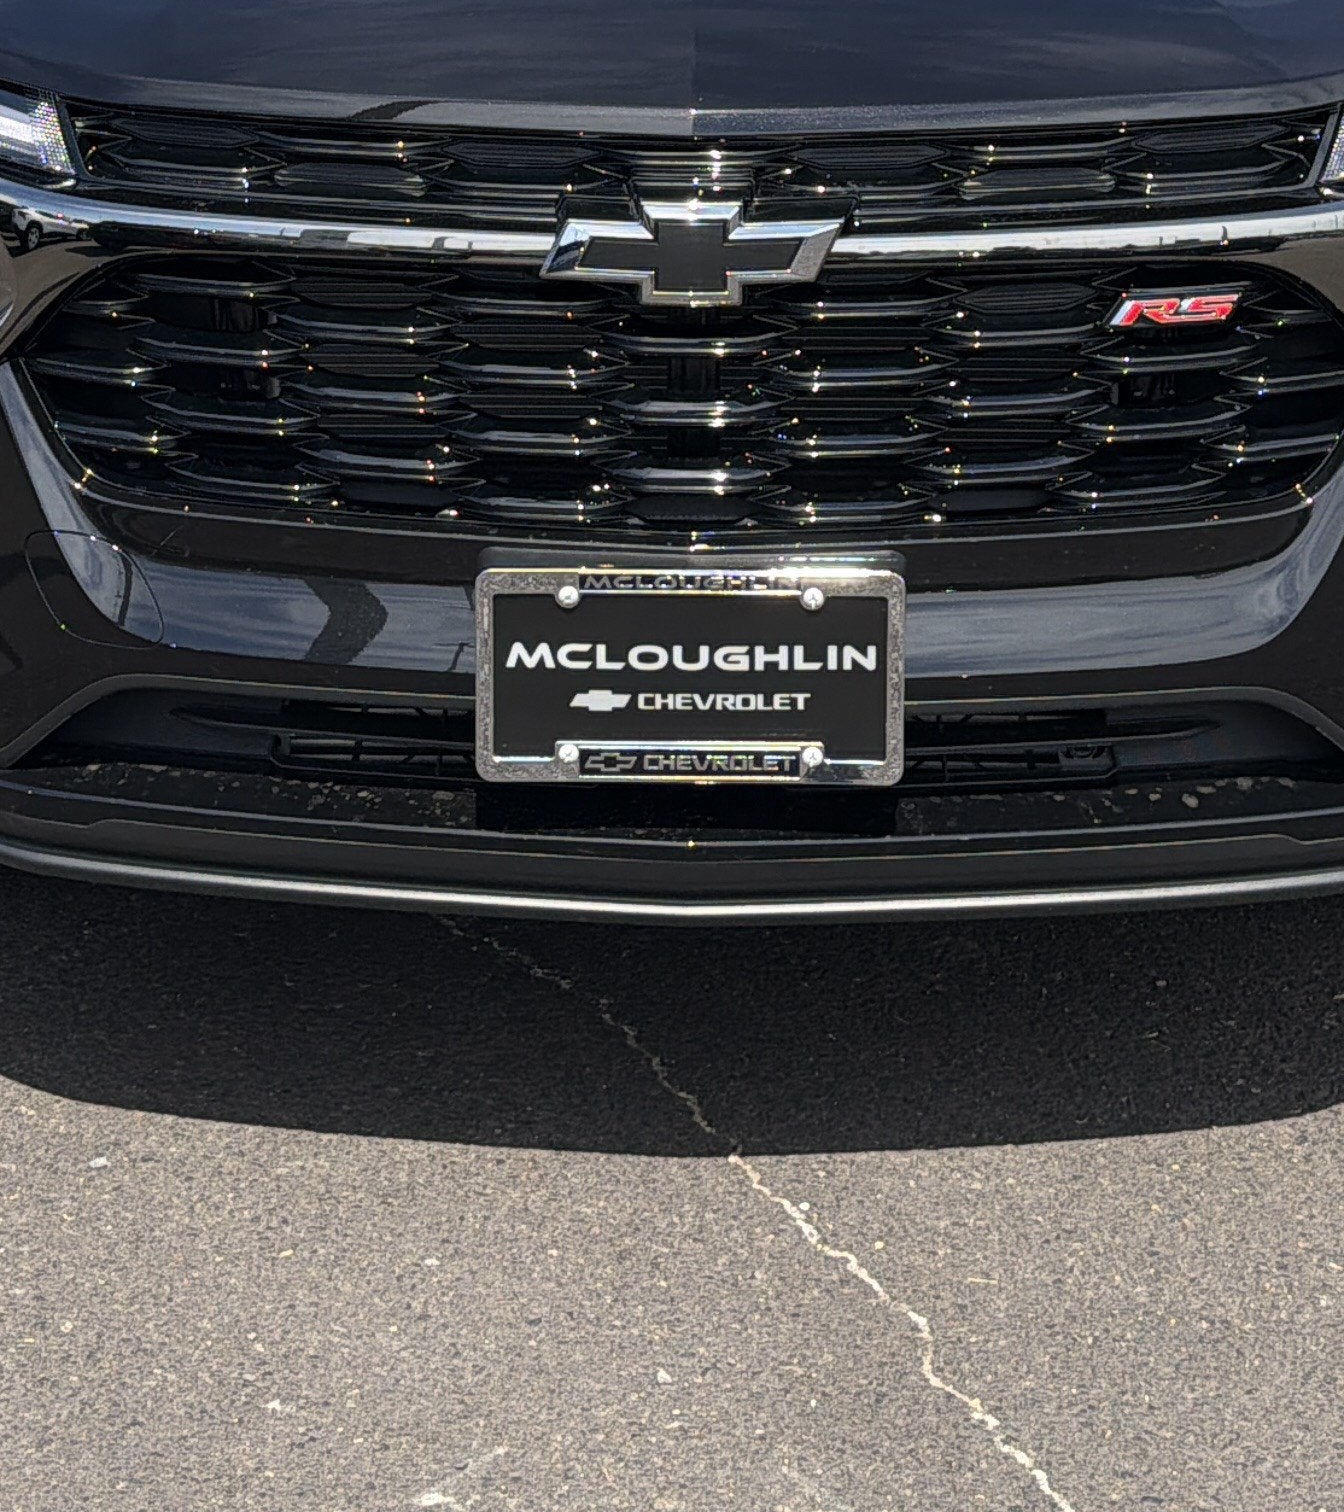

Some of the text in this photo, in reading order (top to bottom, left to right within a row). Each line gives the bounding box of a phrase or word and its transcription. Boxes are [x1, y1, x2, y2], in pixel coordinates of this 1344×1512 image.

[1109, 293, 1239, 326] RS
[505, 642, 877, 672] MCLOUGHLIN
[638, 692, 811, 711] CHEVROLET
[643, 754, 796, 772] CHEVROLET
